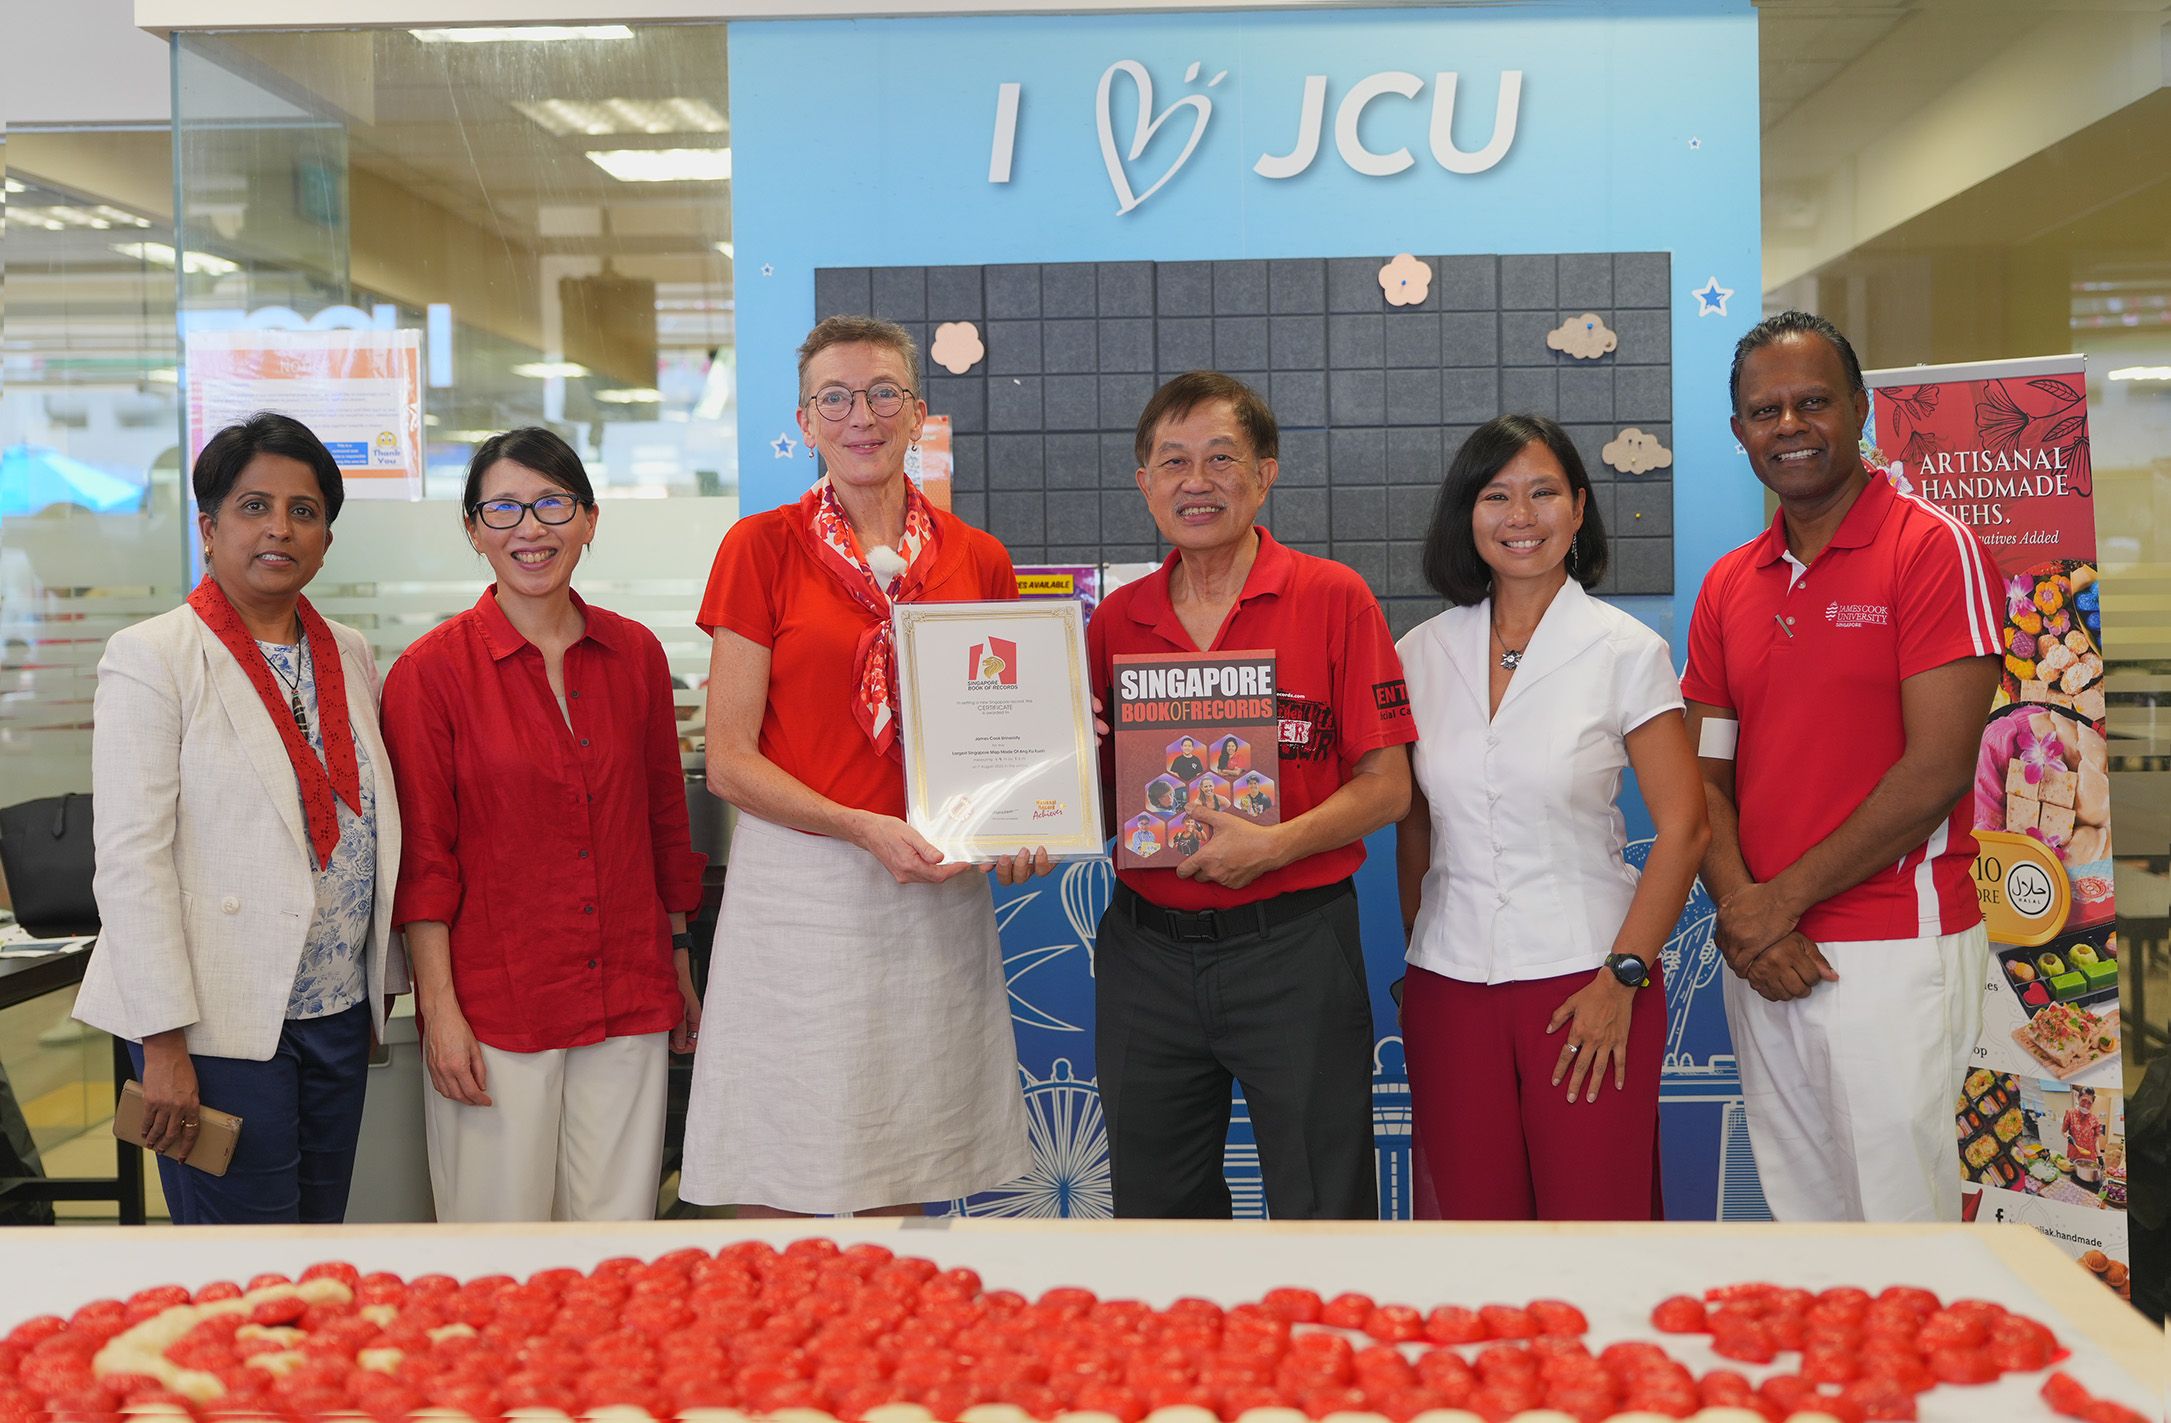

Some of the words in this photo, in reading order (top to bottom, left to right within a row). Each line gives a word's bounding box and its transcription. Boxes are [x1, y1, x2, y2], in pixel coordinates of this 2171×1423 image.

[988, 83, 1021, 183] I
[1252, 70, 1523, 179] JCU
[1919, 447, 2068, 475] ARTISANAL
[1920, 474, 2070, 500] HANDMADE
[2019, 530, 2060, 545] Added
[1028, 580, 1070, 589] AVAILABLE
[1837, 612, 1888, 623] UNIVERSITY
[1839, 604, 1861, 612] JAMES
[1861, 604, 1888, 614] COOK
[1120, 665, 1272, 700] SINGAPORE
[1976, 856, 2002, 883] 10
[2012, 876, 2047, 897] حلال
